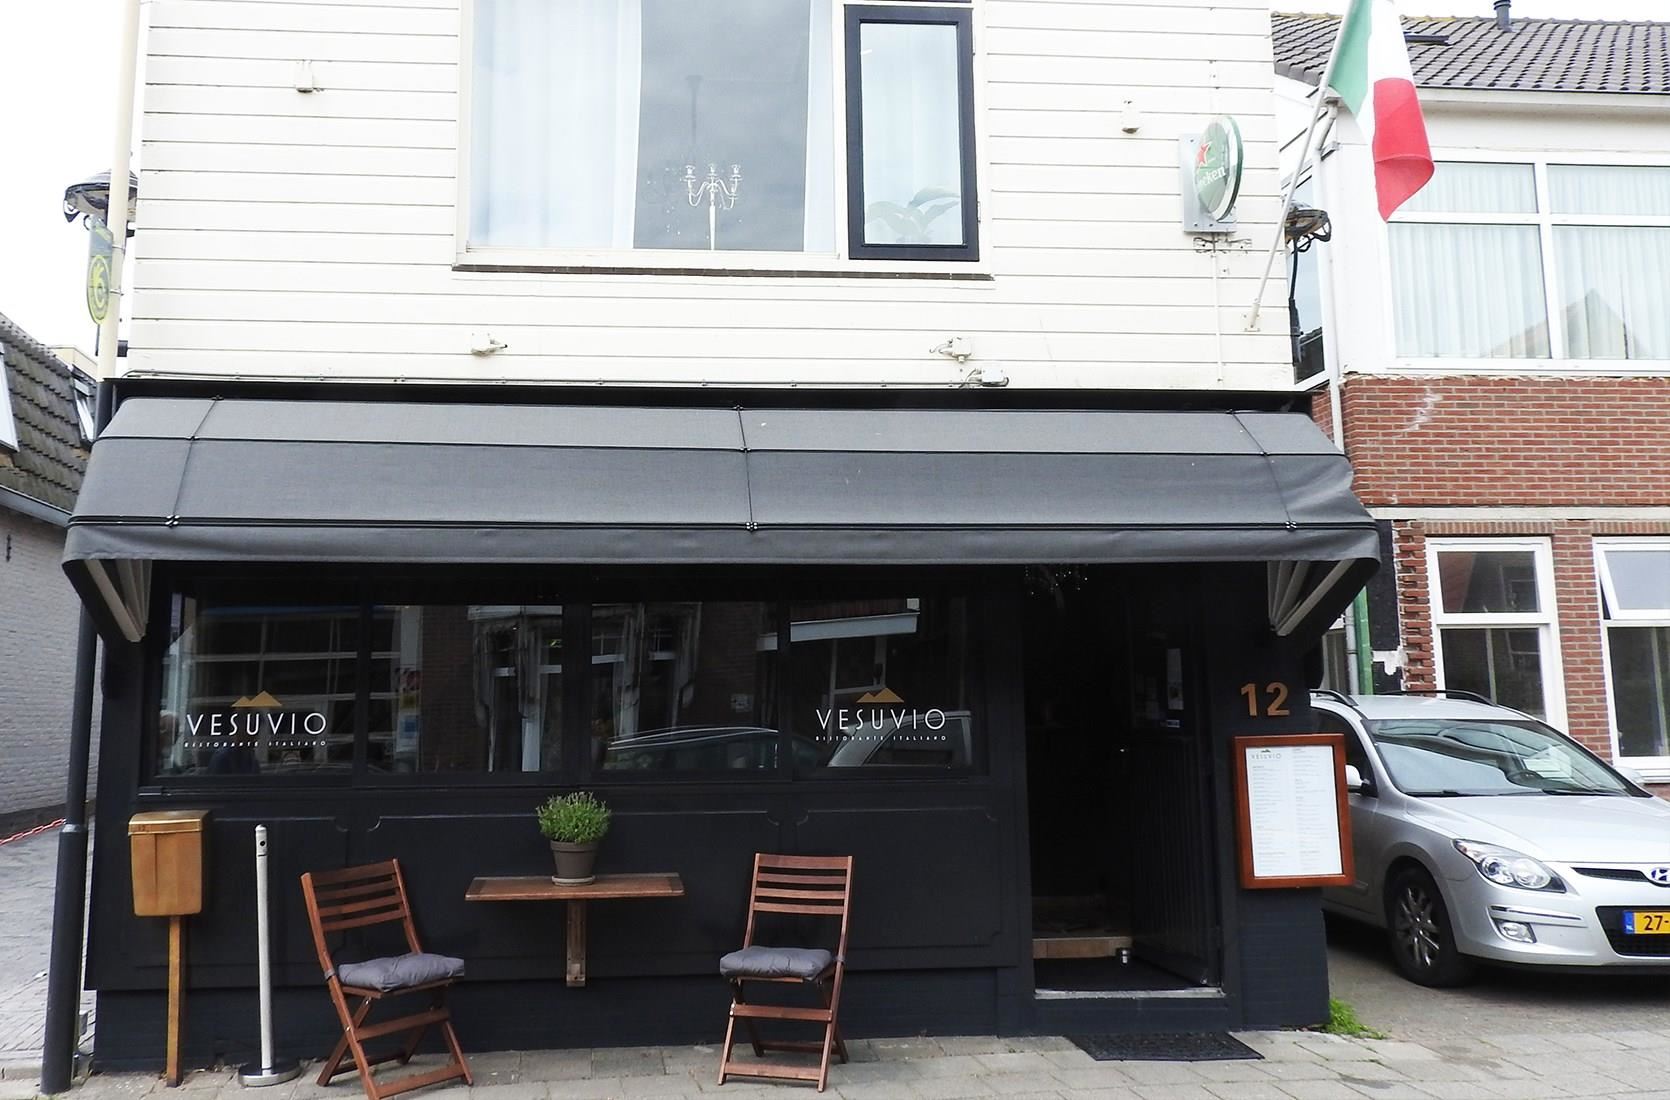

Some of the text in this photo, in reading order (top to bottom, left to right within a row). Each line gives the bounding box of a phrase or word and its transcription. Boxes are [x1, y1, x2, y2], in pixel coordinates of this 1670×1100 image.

[1240, 682, 1290, 717] 12
[186, 712, 327, 736] VESUVIO
[815, 708, 946, 730] VESUVIO
